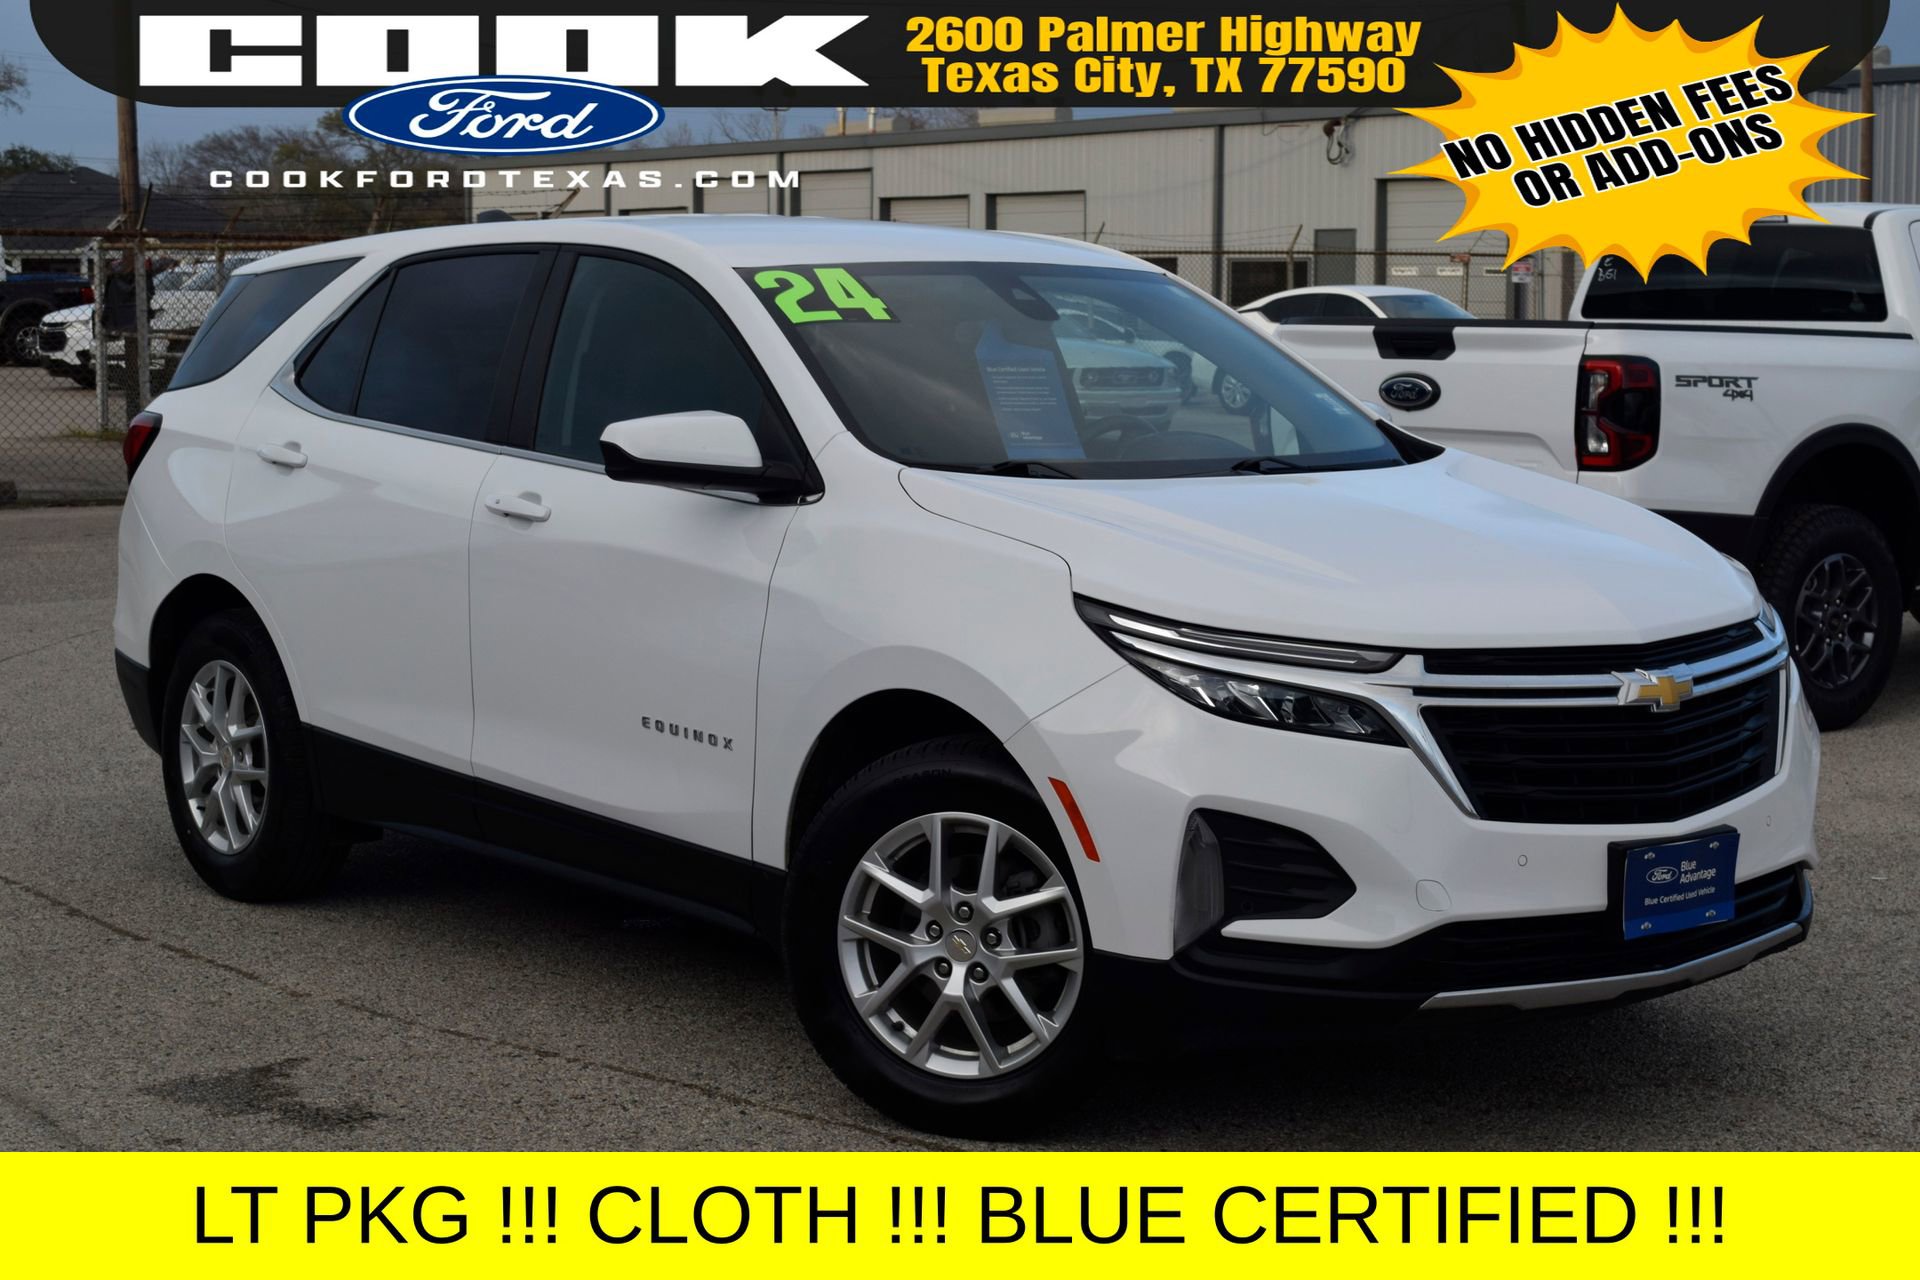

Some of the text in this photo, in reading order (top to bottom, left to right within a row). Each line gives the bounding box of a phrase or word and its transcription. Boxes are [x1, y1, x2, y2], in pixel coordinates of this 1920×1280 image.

[753, 267, 892, 324] 24
[1675, 375, 1759, 388] SPORT
[641, 715, 734, 752] EQUINOX
[1680, 859, 1697, 872] Blue
[1679, 867, 1717, 884] Advantage
[1644, 886, 1716, 906] Blue Certified Used Vehicle
